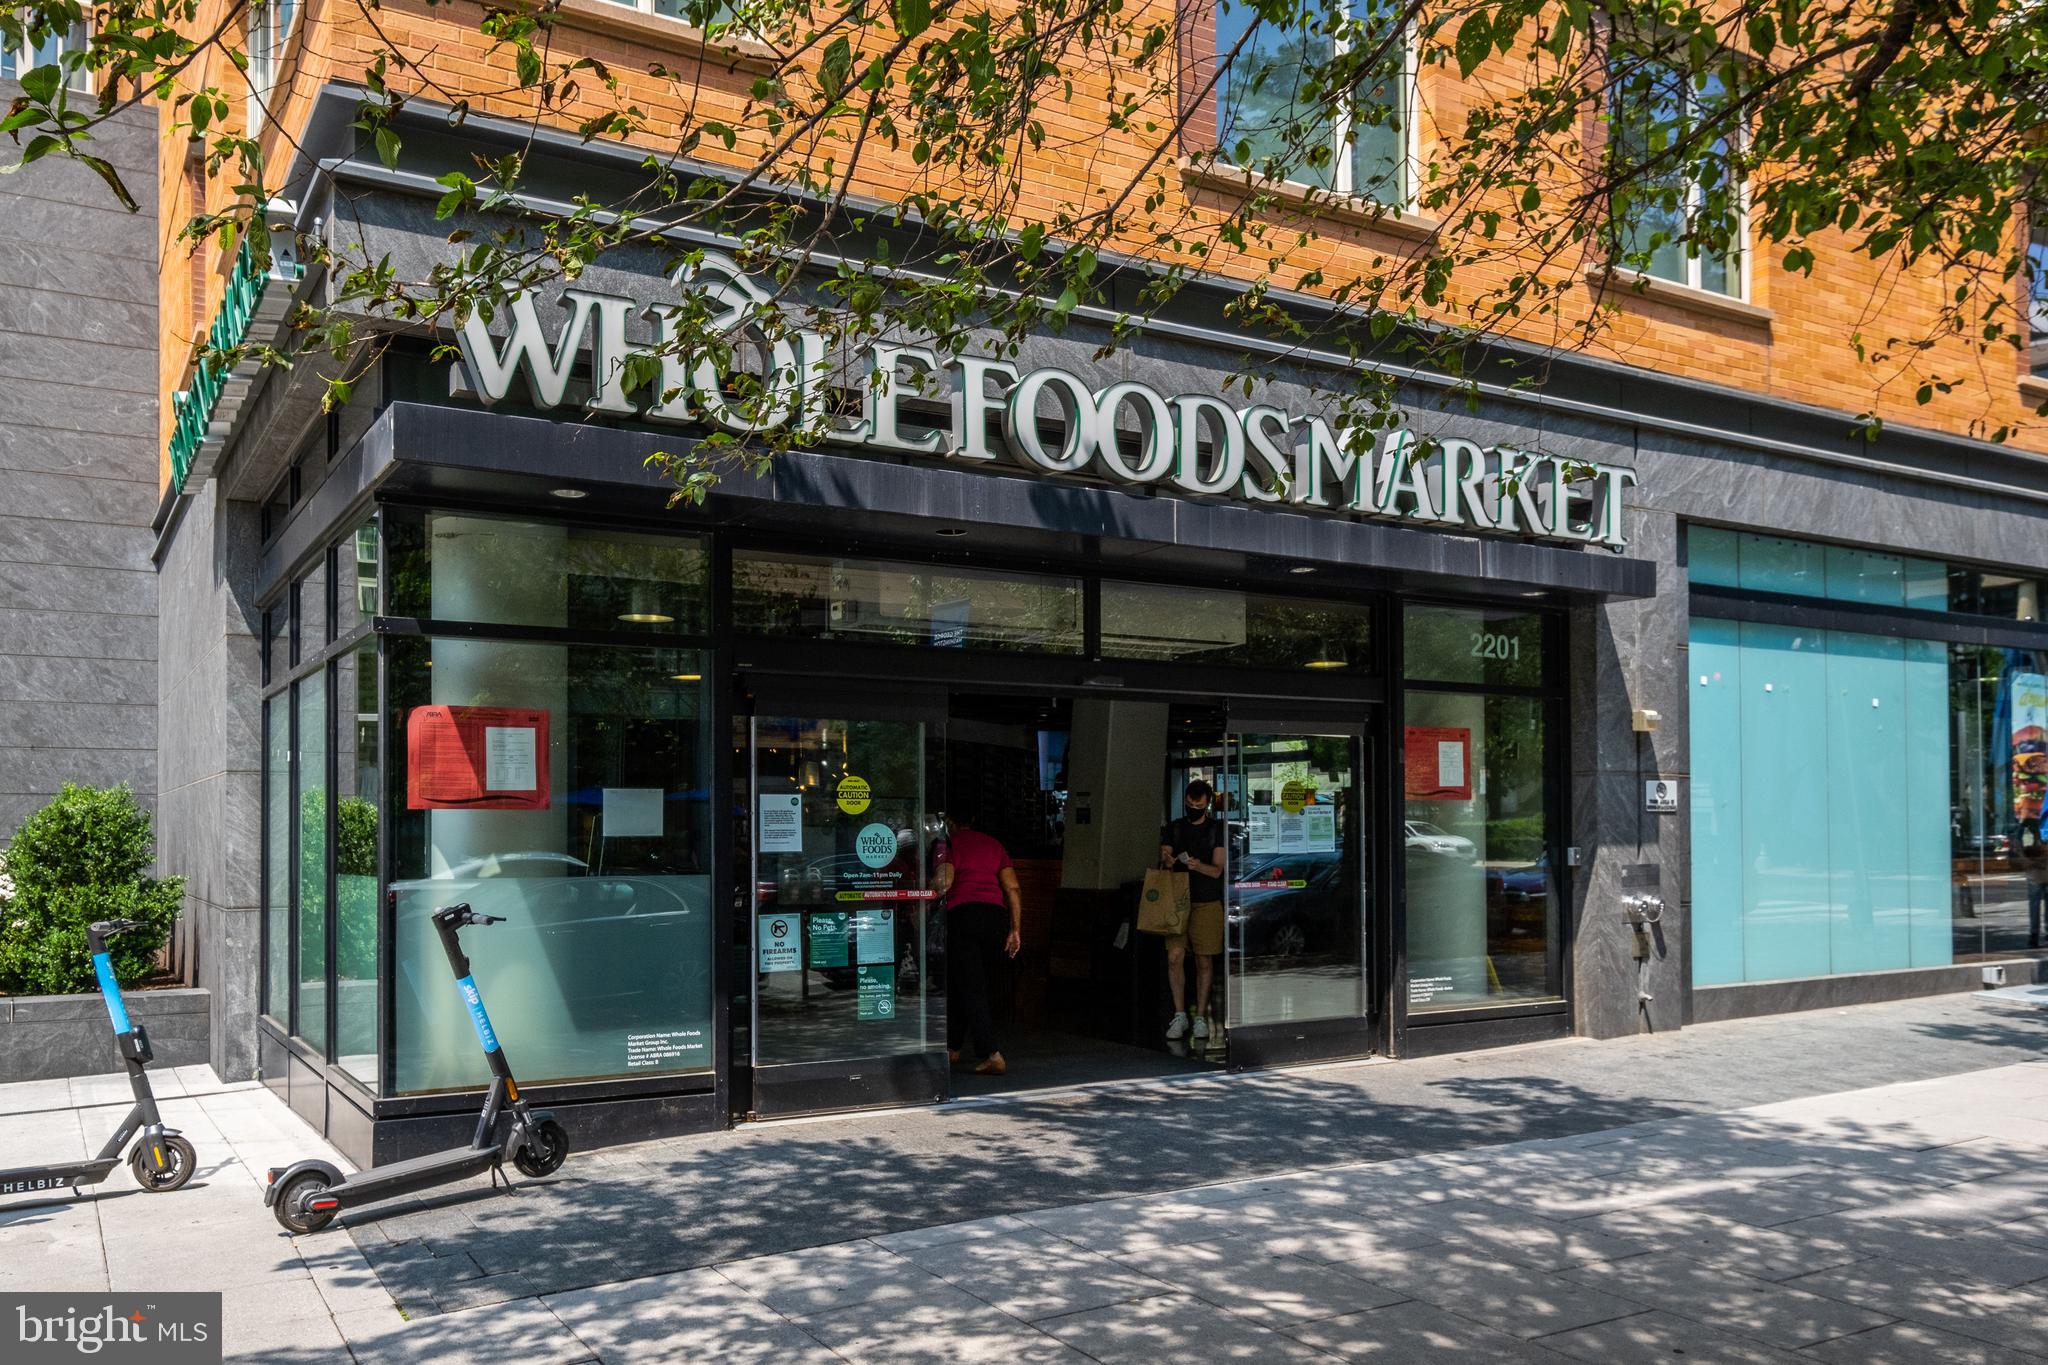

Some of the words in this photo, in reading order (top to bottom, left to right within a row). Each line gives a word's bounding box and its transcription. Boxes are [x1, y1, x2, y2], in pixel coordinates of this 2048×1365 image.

[450, 258, 943, 454] WHOLE
[943, 352, 1293, 501] FOODS
[1292, 413, 1638, 553] MARKET
[1470, 633, 1519, 660] 2201
[838, 791, 870, 799] CAUTION
[860, 834, 892, 846] WHOLE
[862, 846, 892, 854] FOODS
[464, 984, 479, 1005] skip
[476, 1010, 494, 1045] HELBIZ
[4, 1178, 64, 1192] HELBIZ
